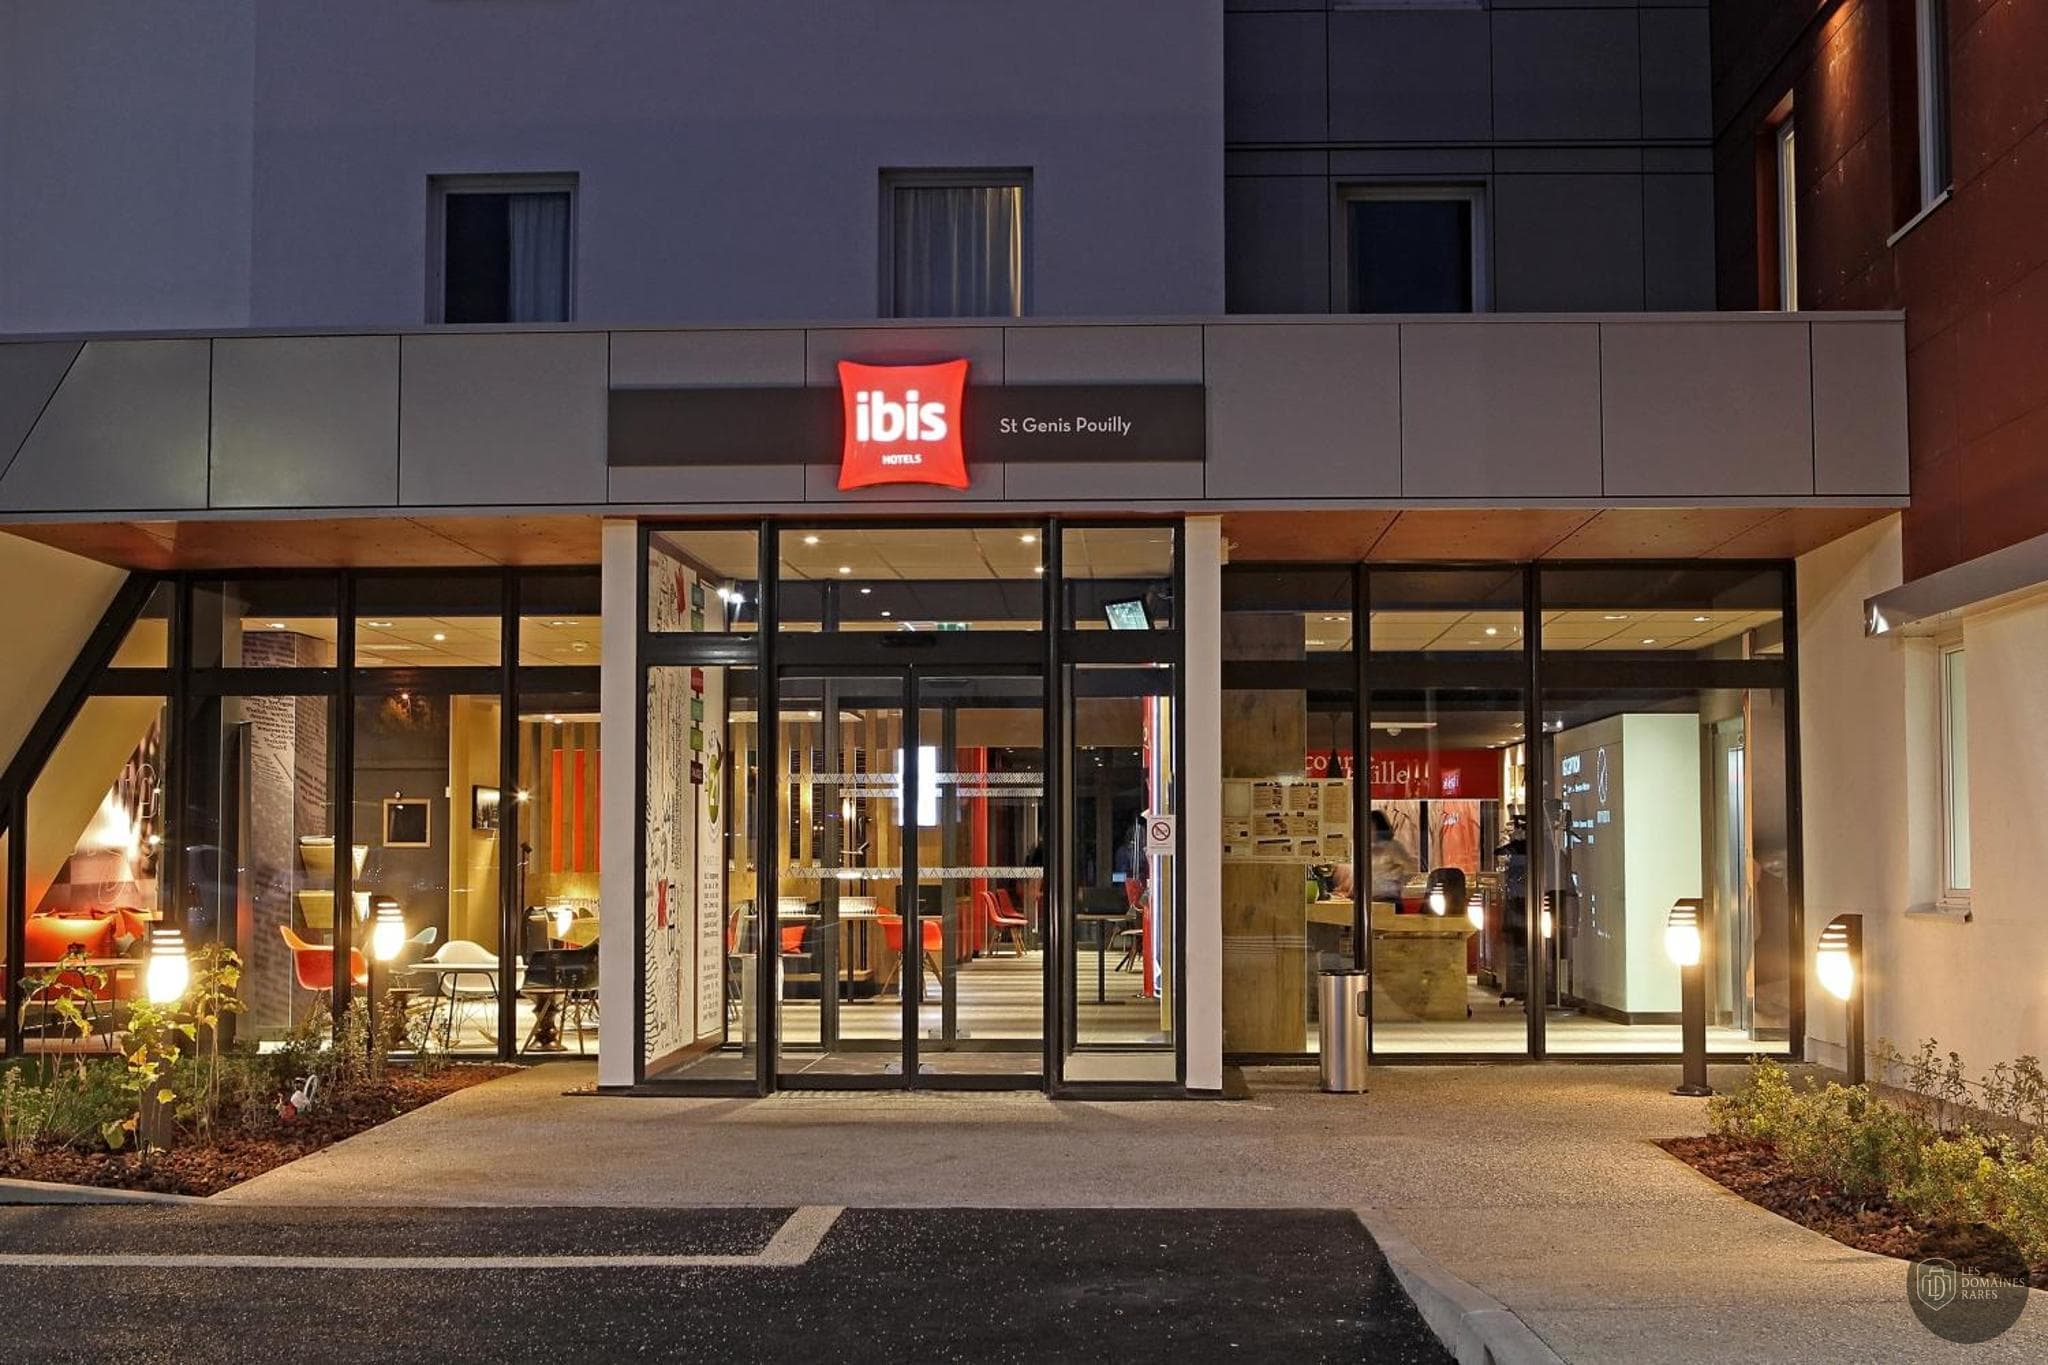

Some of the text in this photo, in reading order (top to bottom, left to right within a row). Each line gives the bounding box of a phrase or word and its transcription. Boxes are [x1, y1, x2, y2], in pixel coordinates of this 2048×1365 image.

[856, 389, 948, 443] ibis
[999, 415, 1132, 436] St Genis Pouilly
[881, 453, 923, 466] HOTELS
